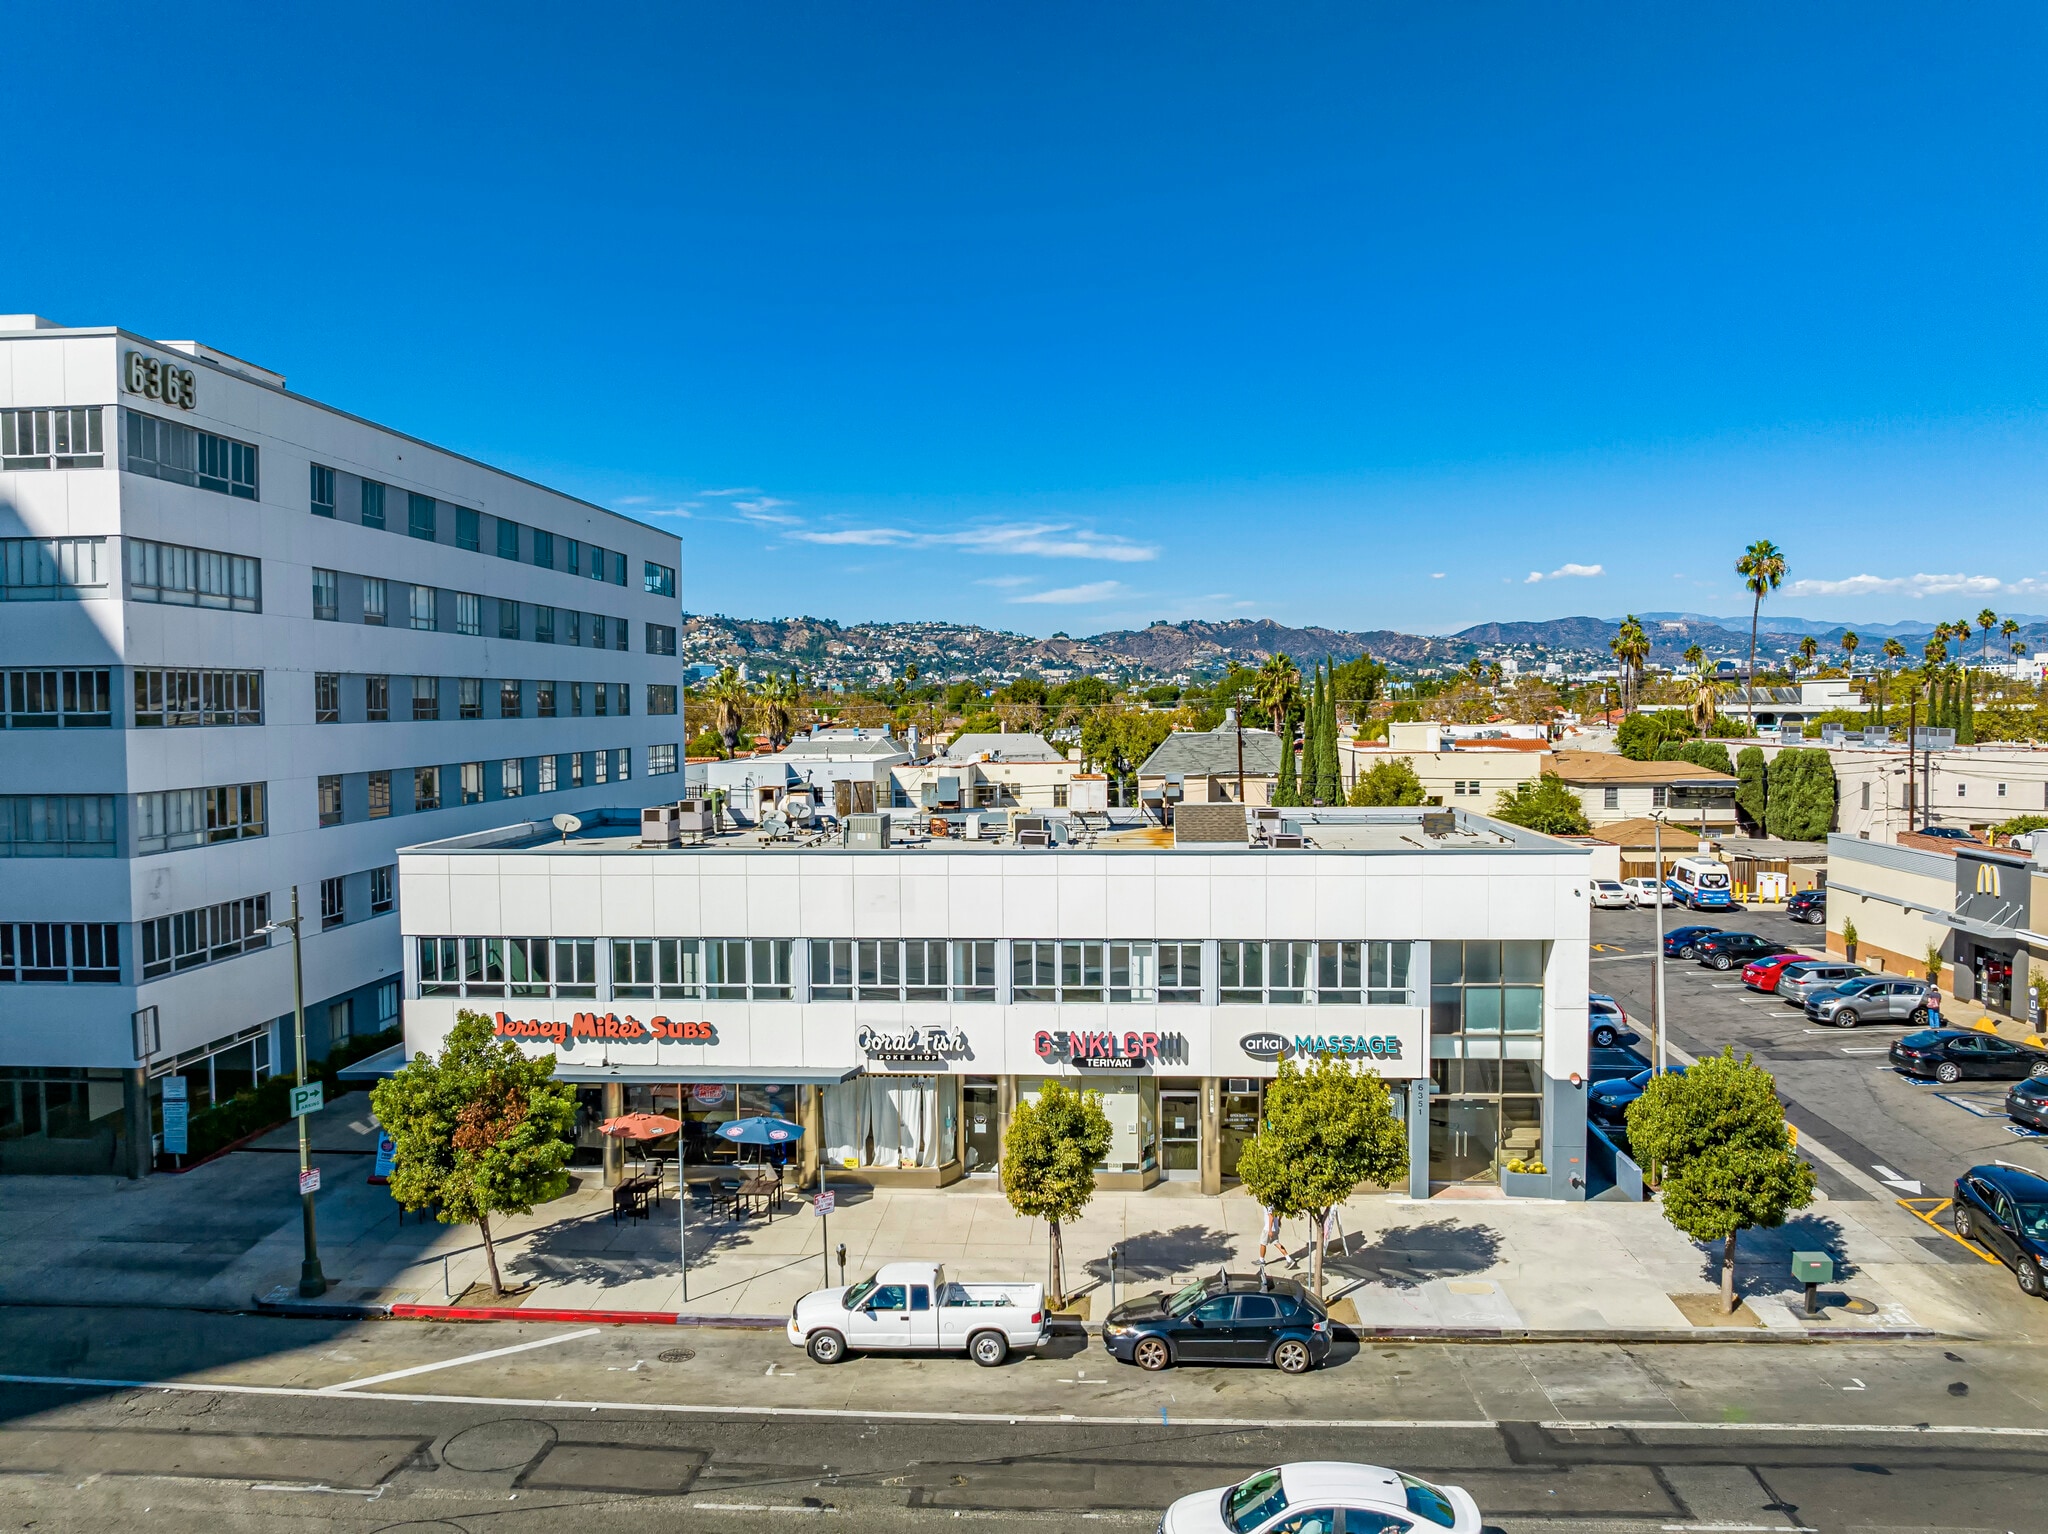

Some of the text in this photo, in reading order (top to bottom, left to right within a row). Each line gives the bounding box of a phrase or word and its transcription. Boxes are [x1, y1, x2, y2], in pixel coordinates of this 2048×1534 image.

[125, 351, 197, 409] 6363
[494, 1012, 567, 1044] Jersey
[572, 1013, 647, 1038] Mike's
[855, 1025, 965, 1053] Coral Fish
[1246, 1035, 1398, 1053] arkai MASSAGE
[1086, 1058, 1132, 1068] TERIYAKI
